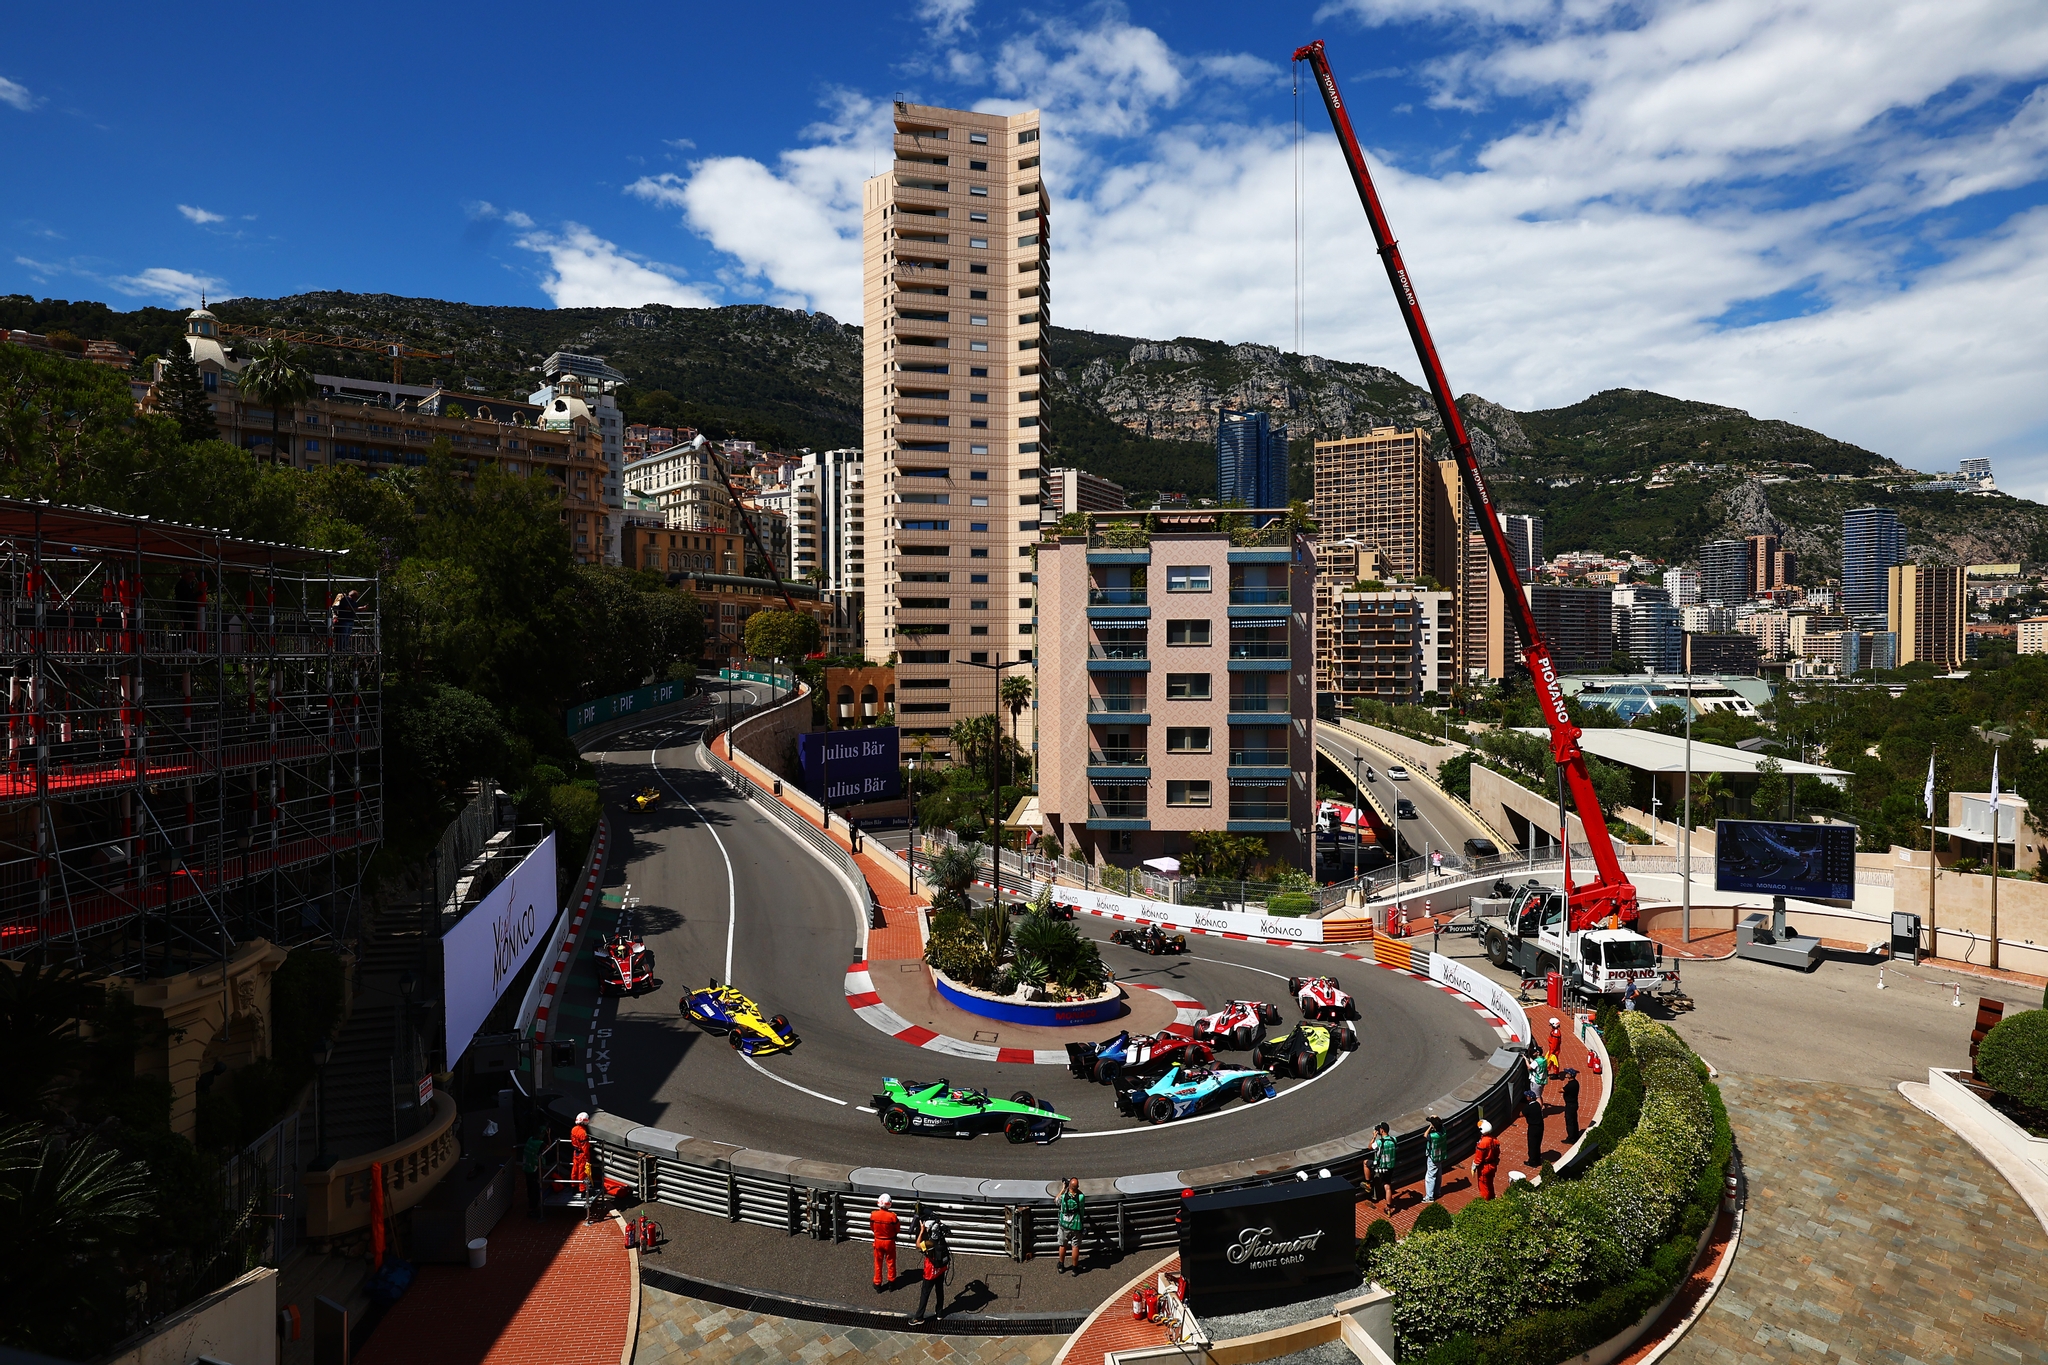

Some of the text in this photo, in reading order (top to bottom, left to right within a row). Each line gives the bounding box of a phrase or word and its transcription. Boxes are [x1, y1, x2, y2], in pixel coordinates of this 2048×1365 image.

[1322, 72, 1341, 109] PIOVANO
[1397, 269, 1415, 306] PIOVANO
[1471, 467, 1489, 505] PIOVANO
[660, 685, 673, 701] PIF
[1537, 657, 1569, 724] PIOVANO
[620, 695, 634, 712] PIF
[584, 705, 596, 724] PIF
[821, 741, 885, 764] Julius Bär
[827, 777, 887, 798] ulius Bär
[1756, 882, 1787, 890] MONACO
[1096, 901, 1119, 912] MONACO
[1141, 909, 1168, 920] MONACO
[1194, 918, 1228, 929] MONACO
[1260, 925, 1303, 937] MONACO
[1448, 924, 1477, 933] PIOVANO
[492, 904, 535, 994] MONACO
[1443, 973, 1472, 993] MONACO
[1608, 969, 1655, 979] PIOVANO
[1055, 1009, 1097, 1020] MONACO
[1490, 998, 1512, 1023] MONACO
[595, 1028, 614, 1086] TAXIS
[1226, 1226, 1325, 1265] Fairmont
[1250, 1254, 1305, 1270] MONTE CARLO
